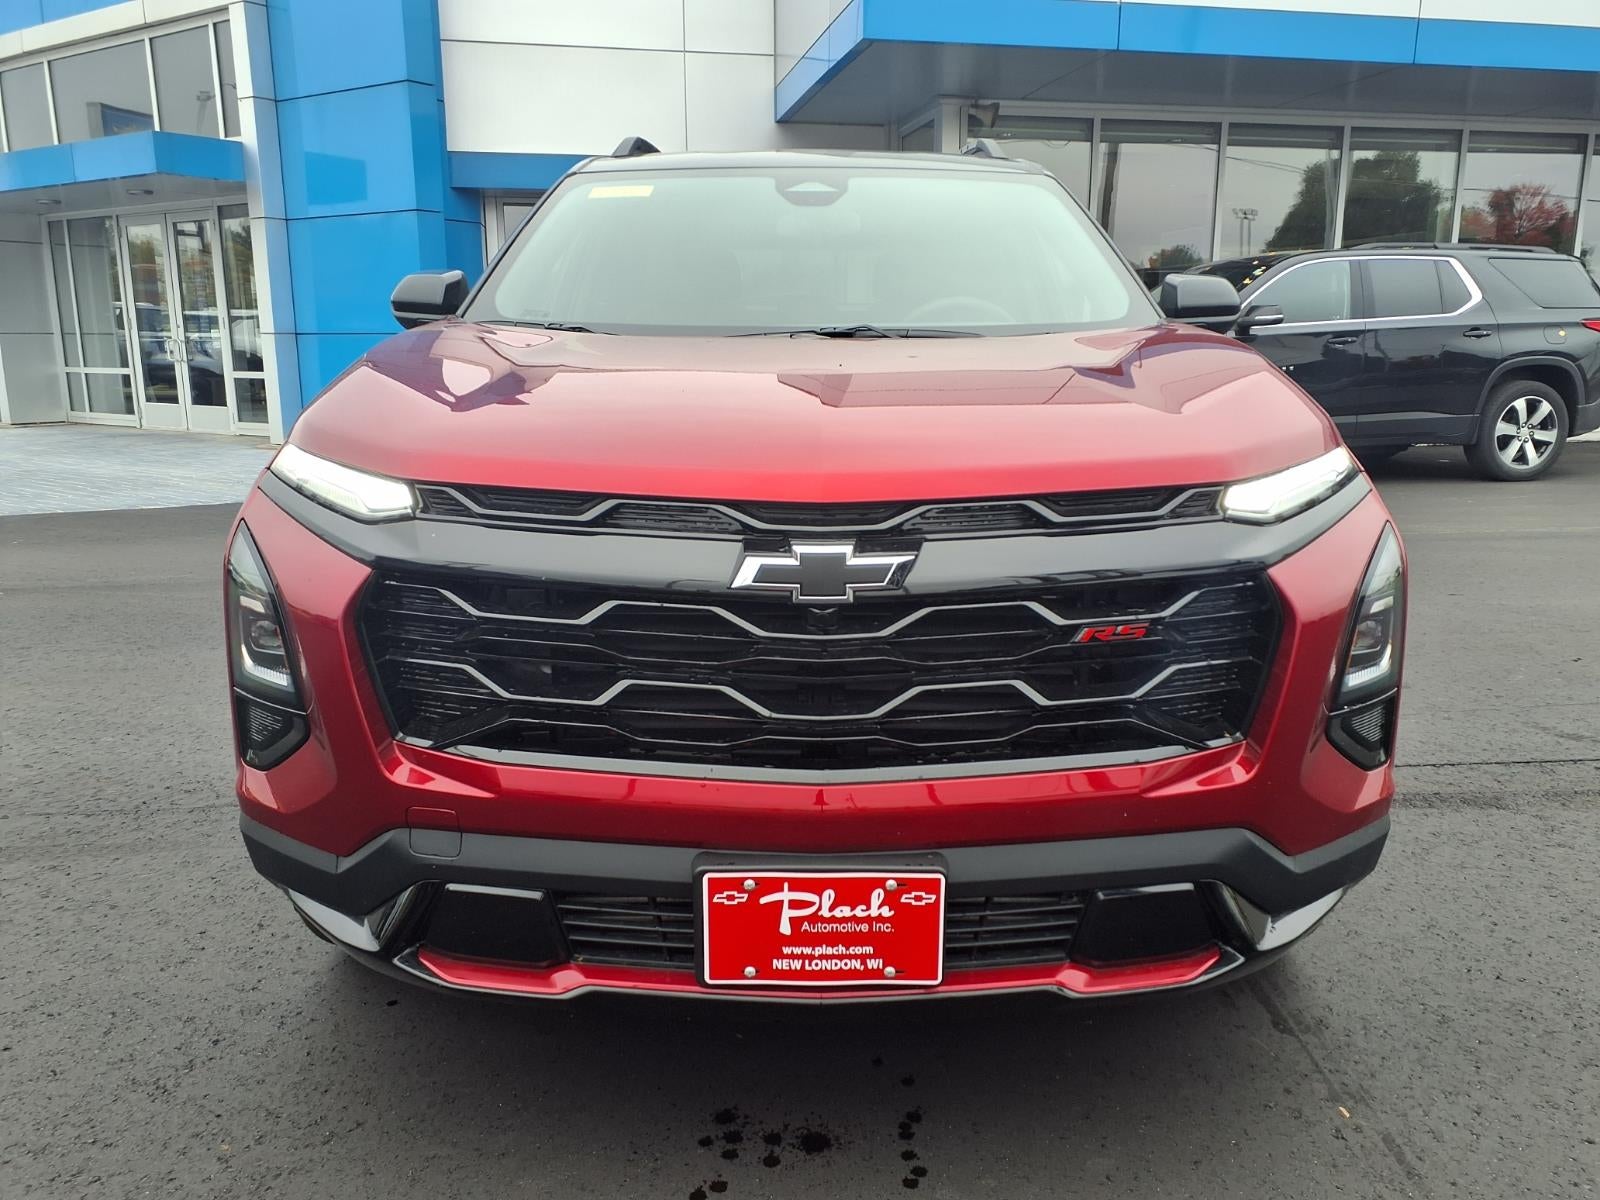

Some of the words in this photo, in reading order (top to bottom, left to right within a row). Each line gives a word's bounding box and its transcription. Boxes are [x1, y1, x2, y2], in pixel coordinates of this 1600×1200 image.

[1074, 622, 1150, 643] RS
[759, 881, 895, 935] Plach
[801, 921, 869, 933] Automotive
[873, 921, 895, 933] Inc.
[782, 944, 873, 956] www.plach.com
[772, 959, 803, 970] NEW
[804, 959, 866, 972] LONDON,
[867, 959, 883, 970] WI
